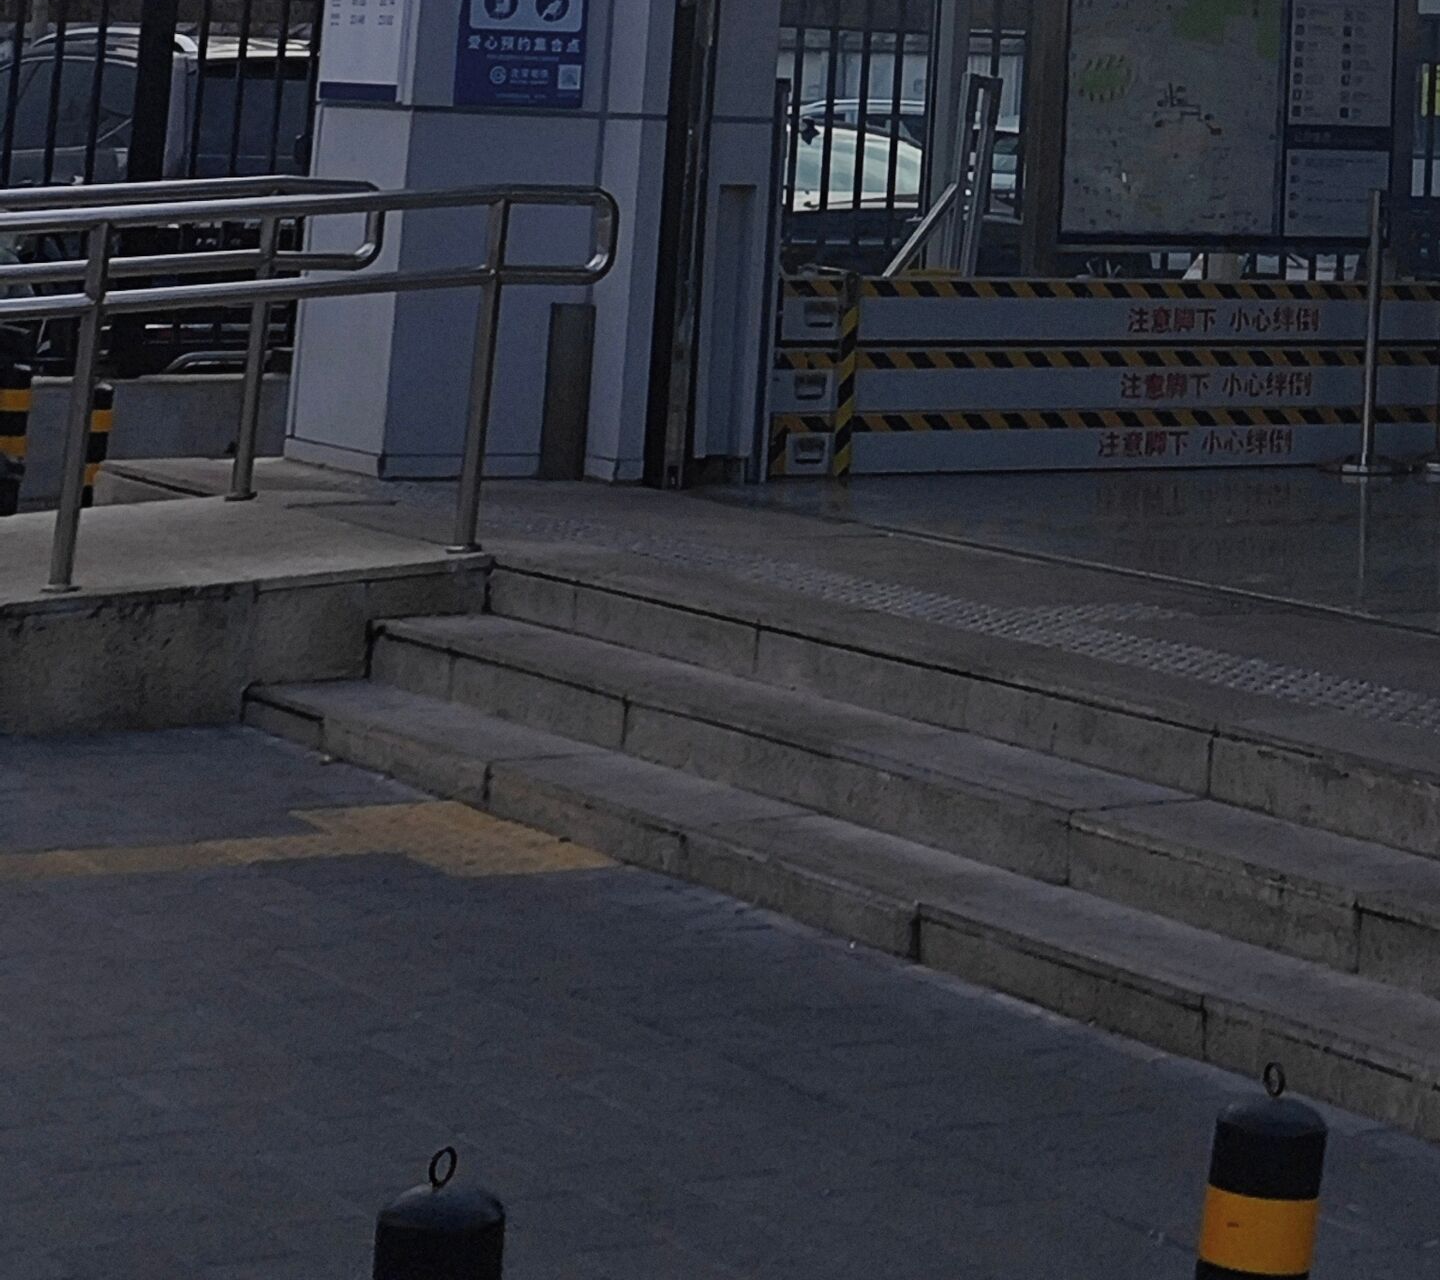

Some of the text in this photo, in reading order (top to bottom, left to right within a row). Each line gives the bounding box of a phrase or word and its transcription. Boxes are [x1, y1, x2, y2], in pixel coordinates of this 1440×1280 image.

[1128, 306, 1320, 334] 注意脚下 小心绊倒
[1120, 371, 1313, 400] 注意脚下 小心绊倒
[1097, 429, 1293, 457] 注意脚下 小心绊倒
